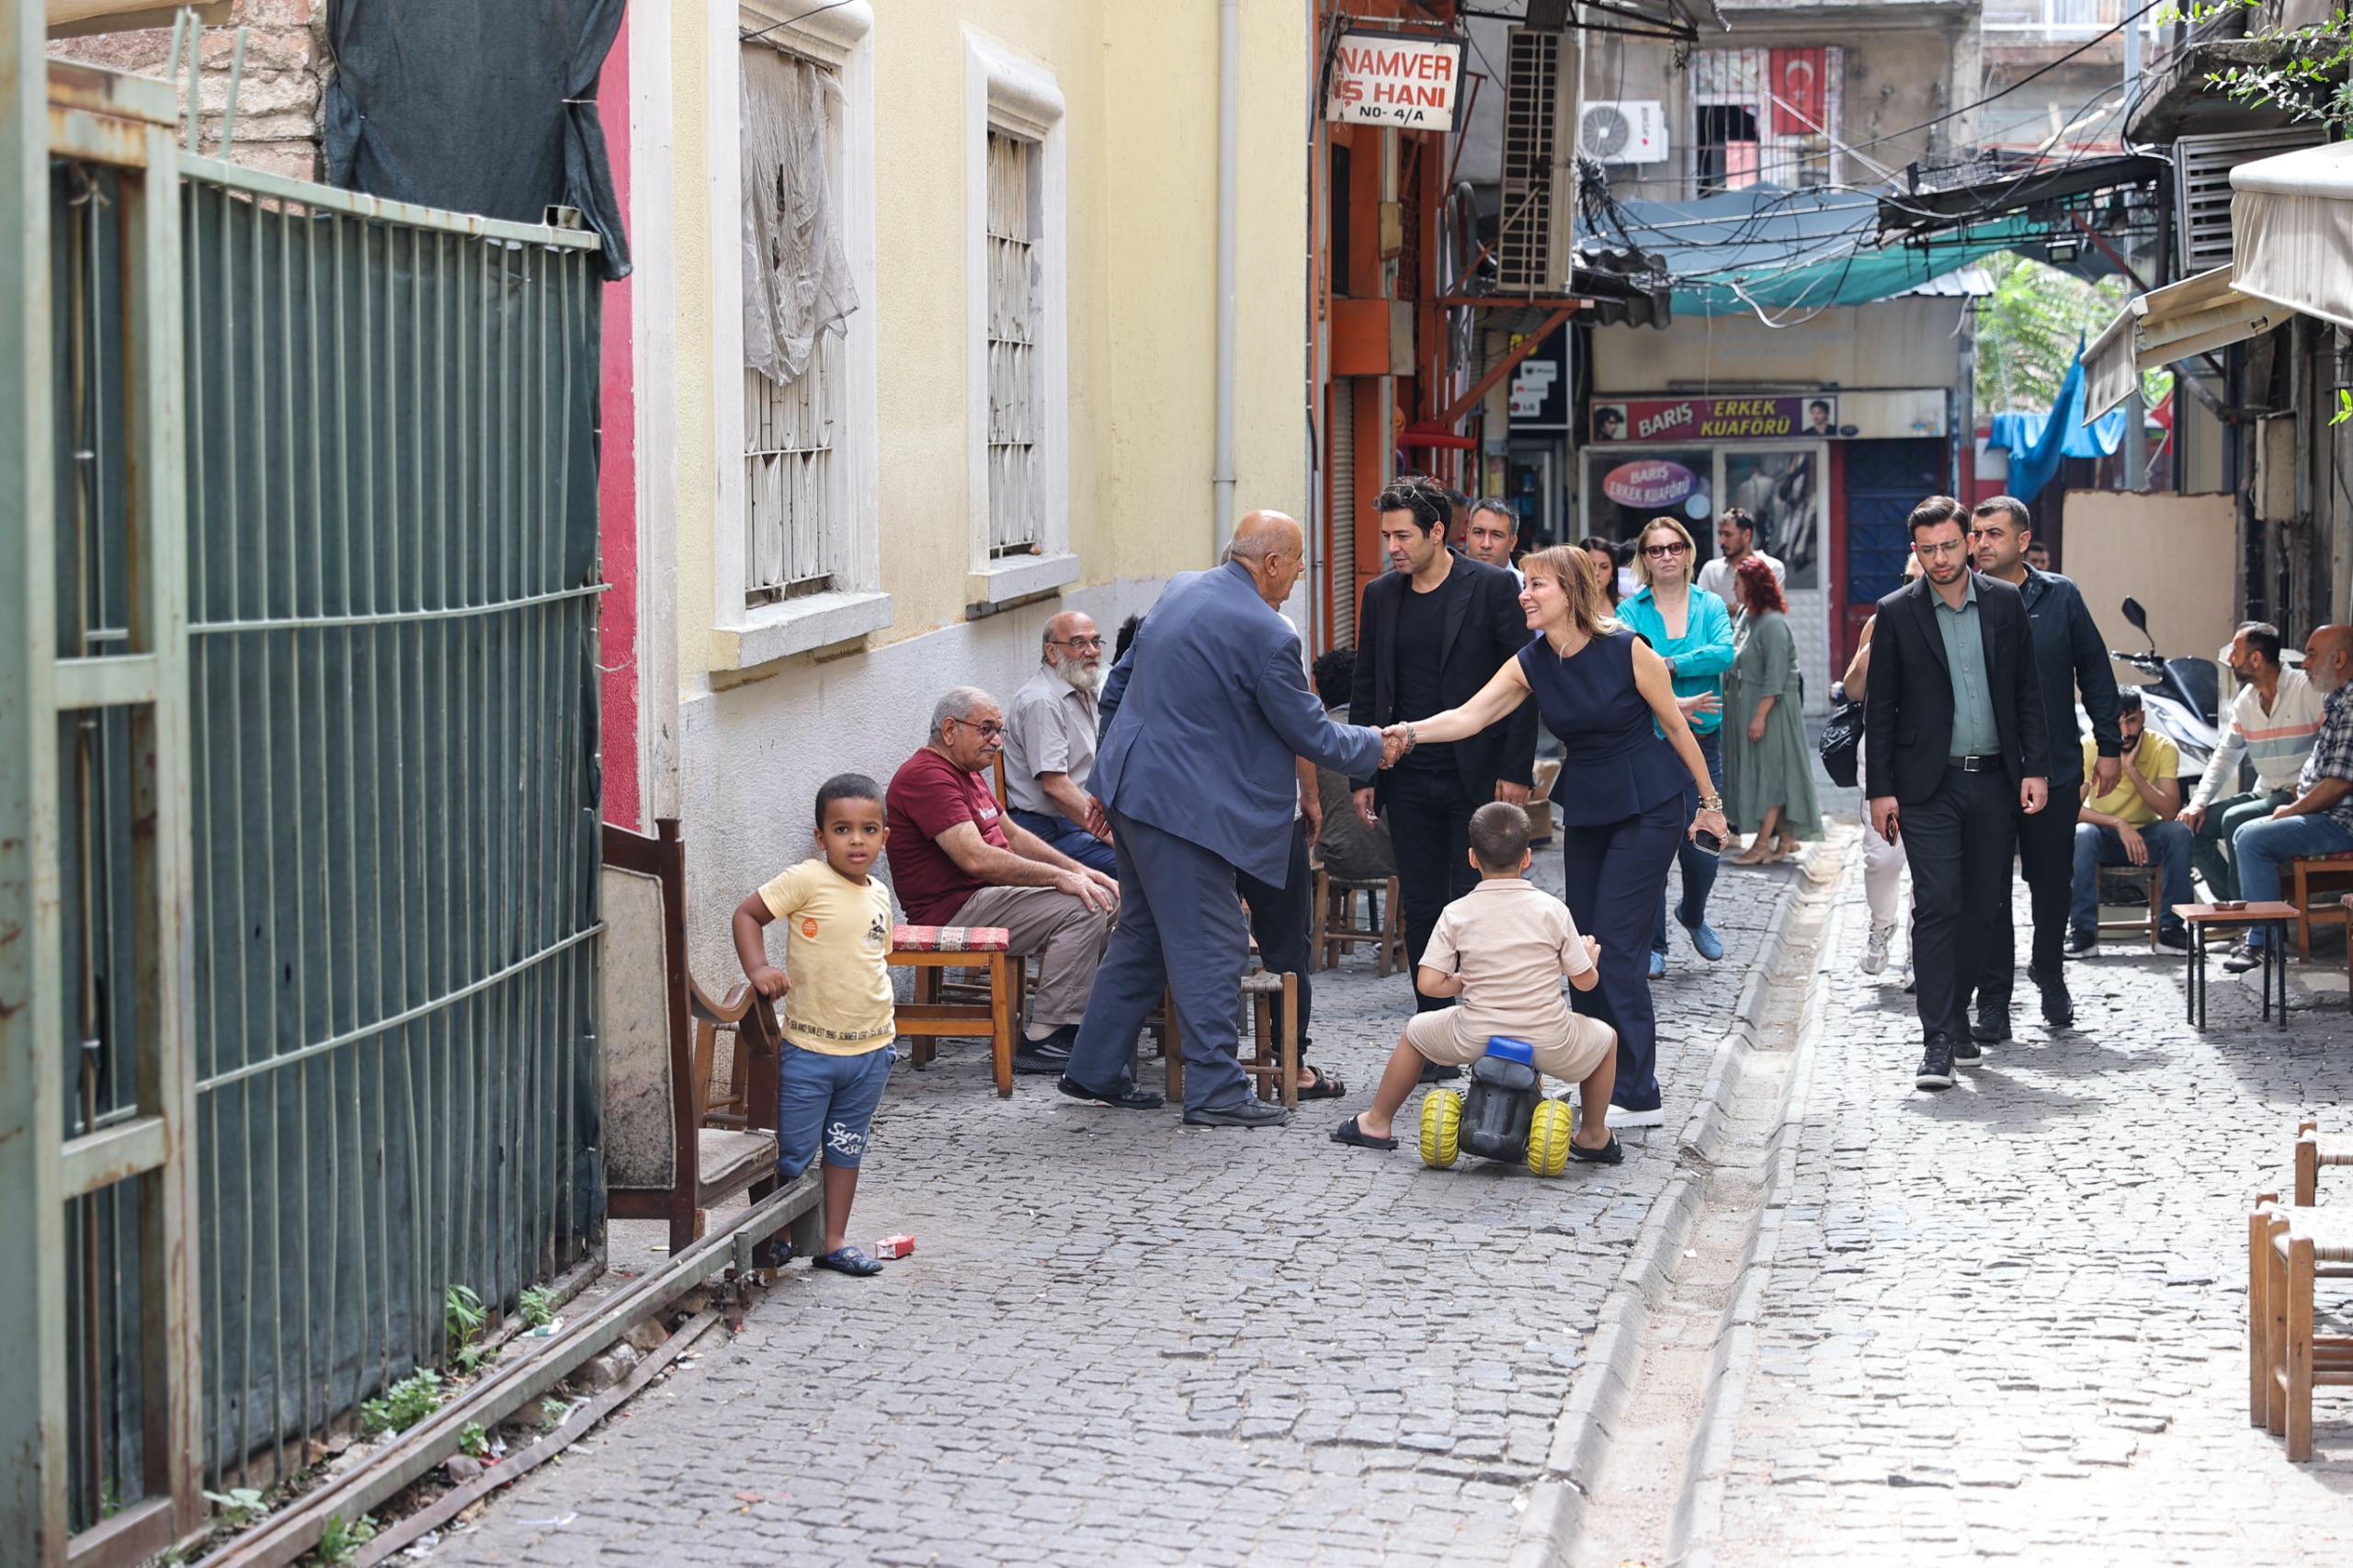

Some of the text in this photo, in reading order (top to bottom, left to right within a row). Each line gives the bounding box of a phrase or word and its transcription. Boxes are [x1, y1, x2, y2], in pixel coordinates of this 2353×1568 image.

[1338, 47, 1452, 82] NAMVER
[1373, 82, 1446, 108] HANI
[1393, 108, 1424, 126] 4/A
[1713, 399, 1778, 417] ERKEK
[1637, 402, 1694, 438] BARIŞ
[1700, 415, 1791, 437] KUAFÖRÜ
[1631, 465, 1670, 485] BARIŞ
[1609, 474, 1691, 503] ERKEK KUAFÖRÜ
[816, 1028, 825, 1038] EST
[825, 1029, 836, 1040] 1990
[827, 1121, 861, 1142] Sun
[827, 1136, 862, 1154] Rise
